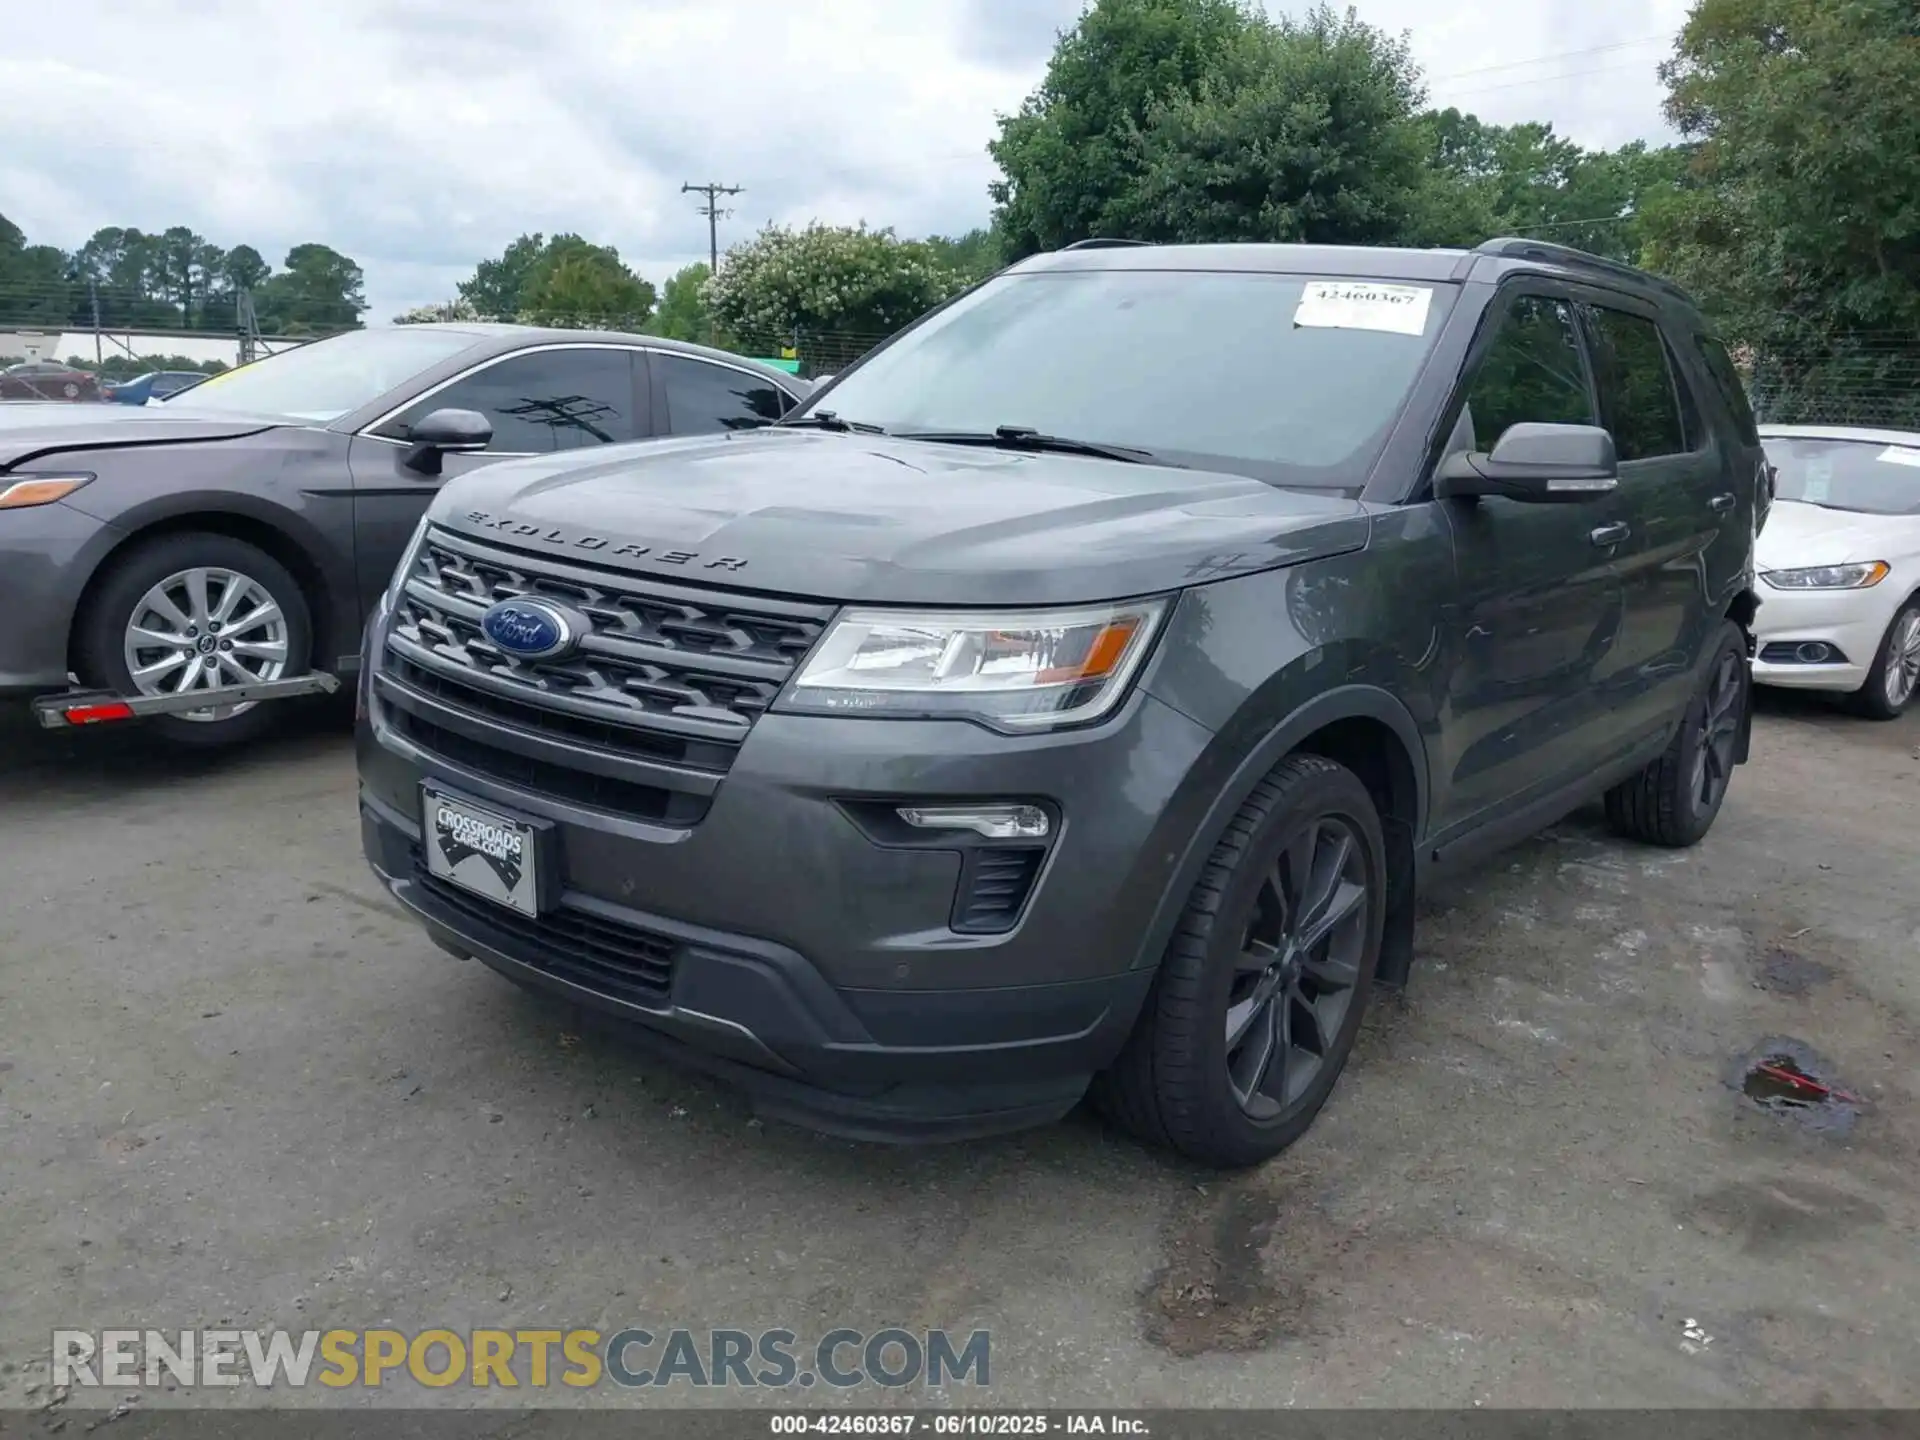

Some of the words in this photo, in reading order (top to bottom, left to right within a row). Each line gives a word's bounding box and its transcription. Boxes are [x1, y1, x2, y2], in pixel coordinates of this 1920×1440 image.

[1315, 289, 1416, 305] 42460367
[464, 510, 749, 571] EXPLORER
[493, 607, 543, 645] Ford
[437, 807, 522, 854] CROSSROADS
[452, 829, 508, 861] CARS.COM
